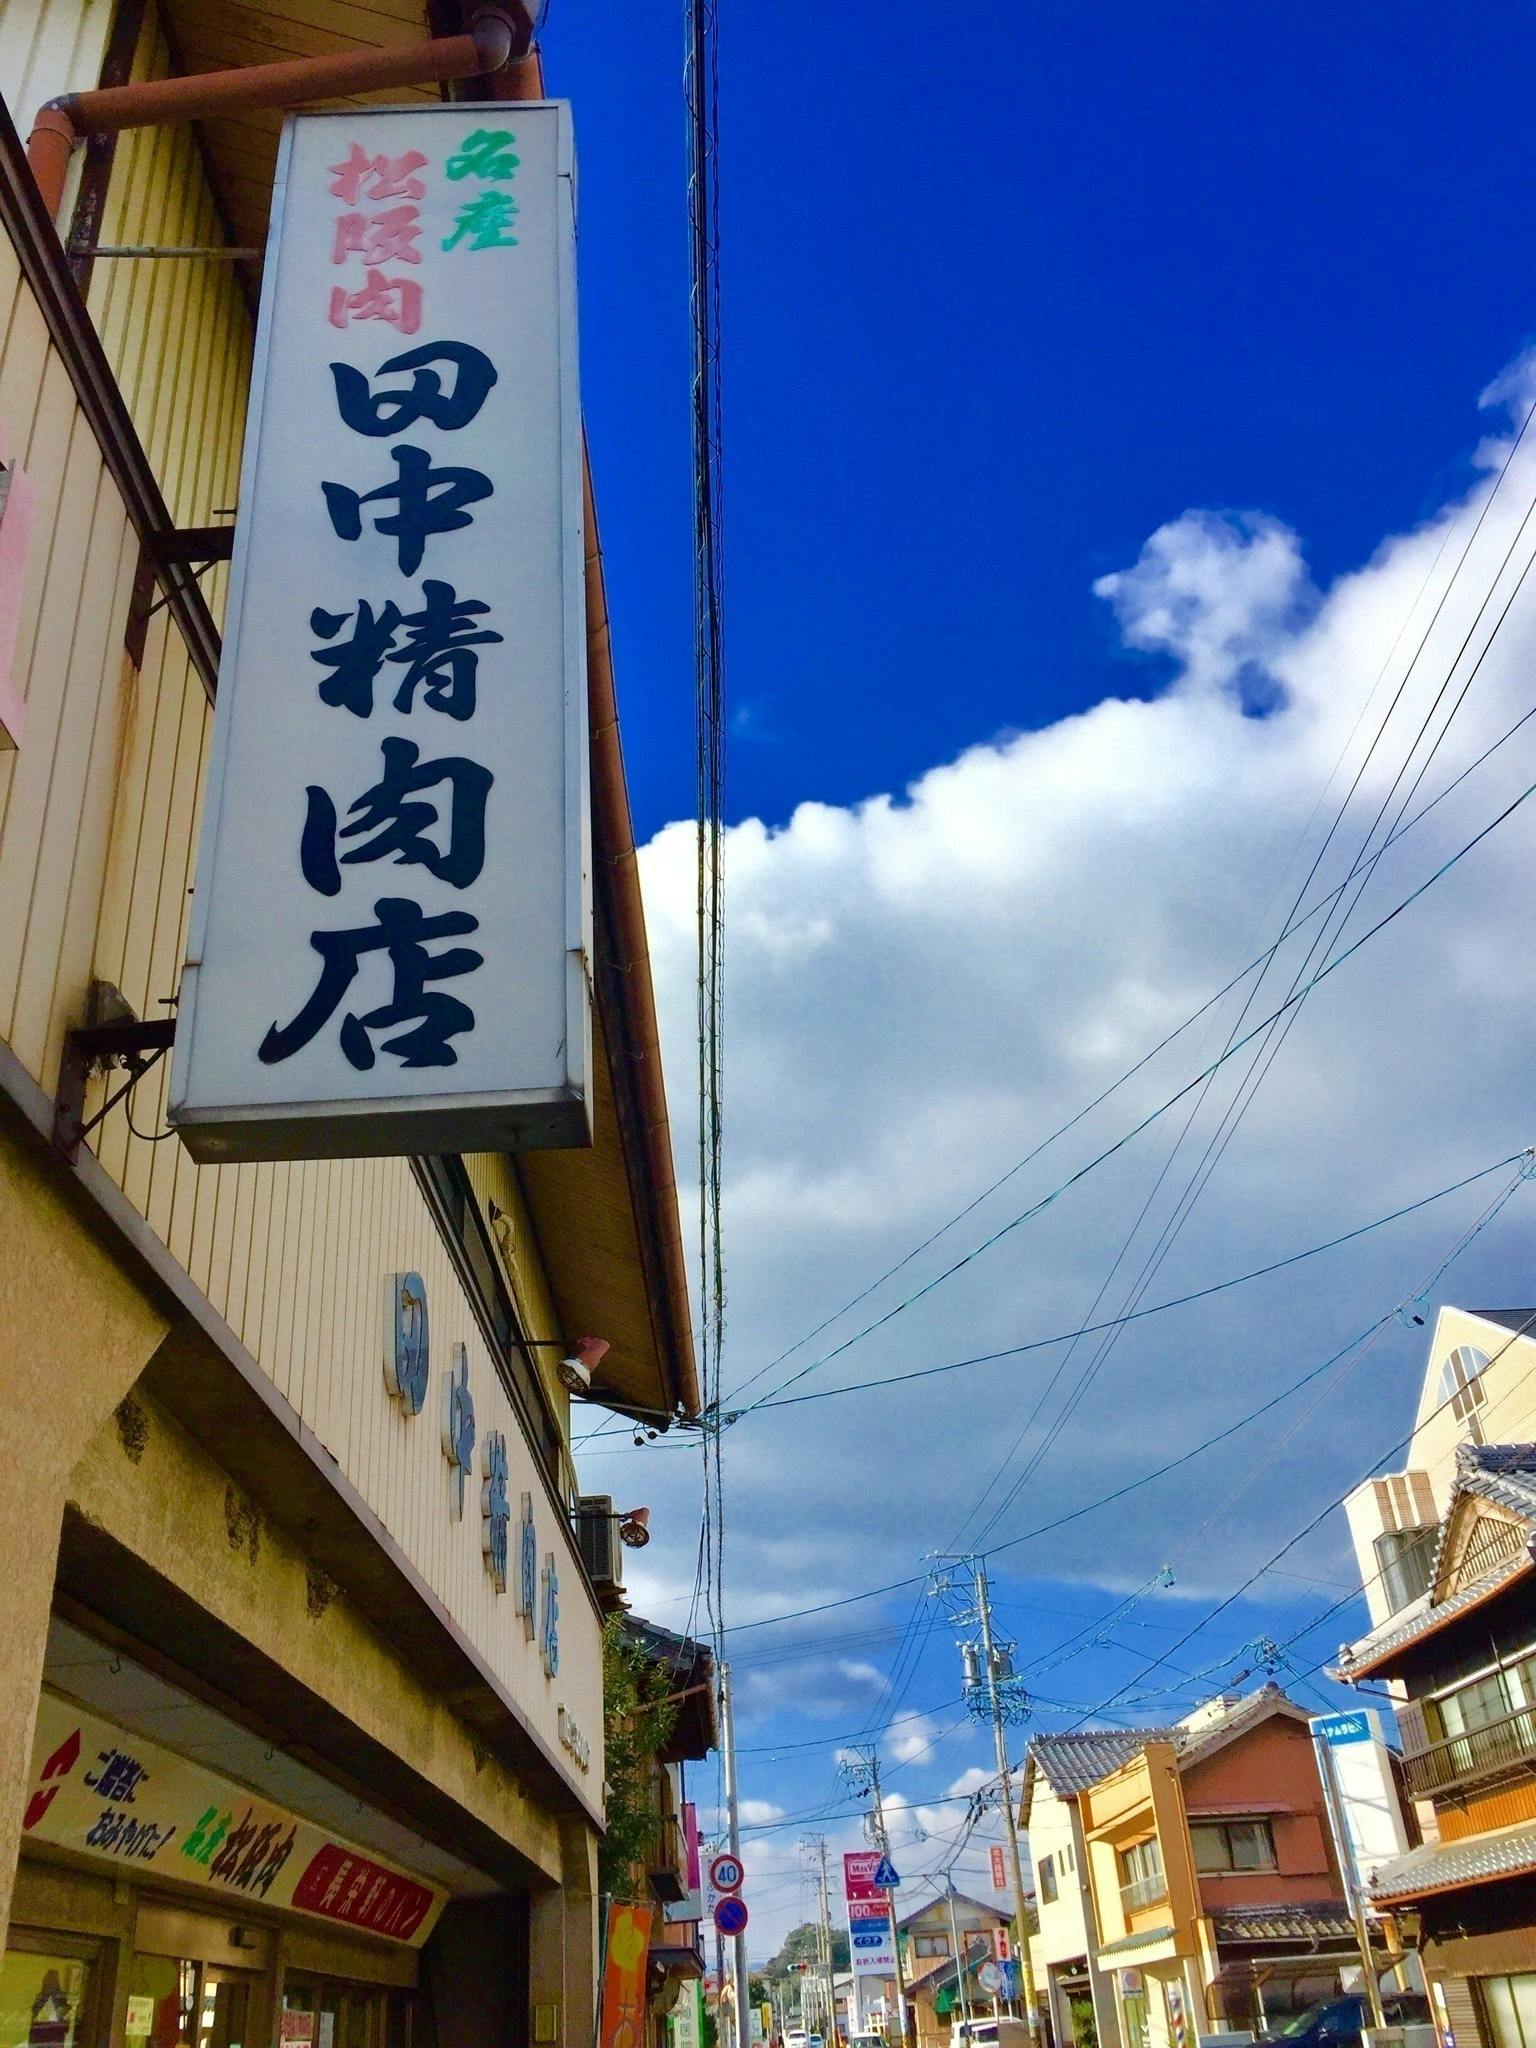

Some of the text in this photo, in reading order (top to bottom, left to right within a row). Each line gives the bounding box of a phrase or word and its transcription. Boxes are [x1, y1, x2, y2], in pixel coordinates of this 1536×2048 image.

[328, 142, 428, 334] 松阪肉
[443, 129, 521, 251] 名産
[258, 341, 503, 1070] 田中精肉店
[718, 1865, 737, 1883] 40
